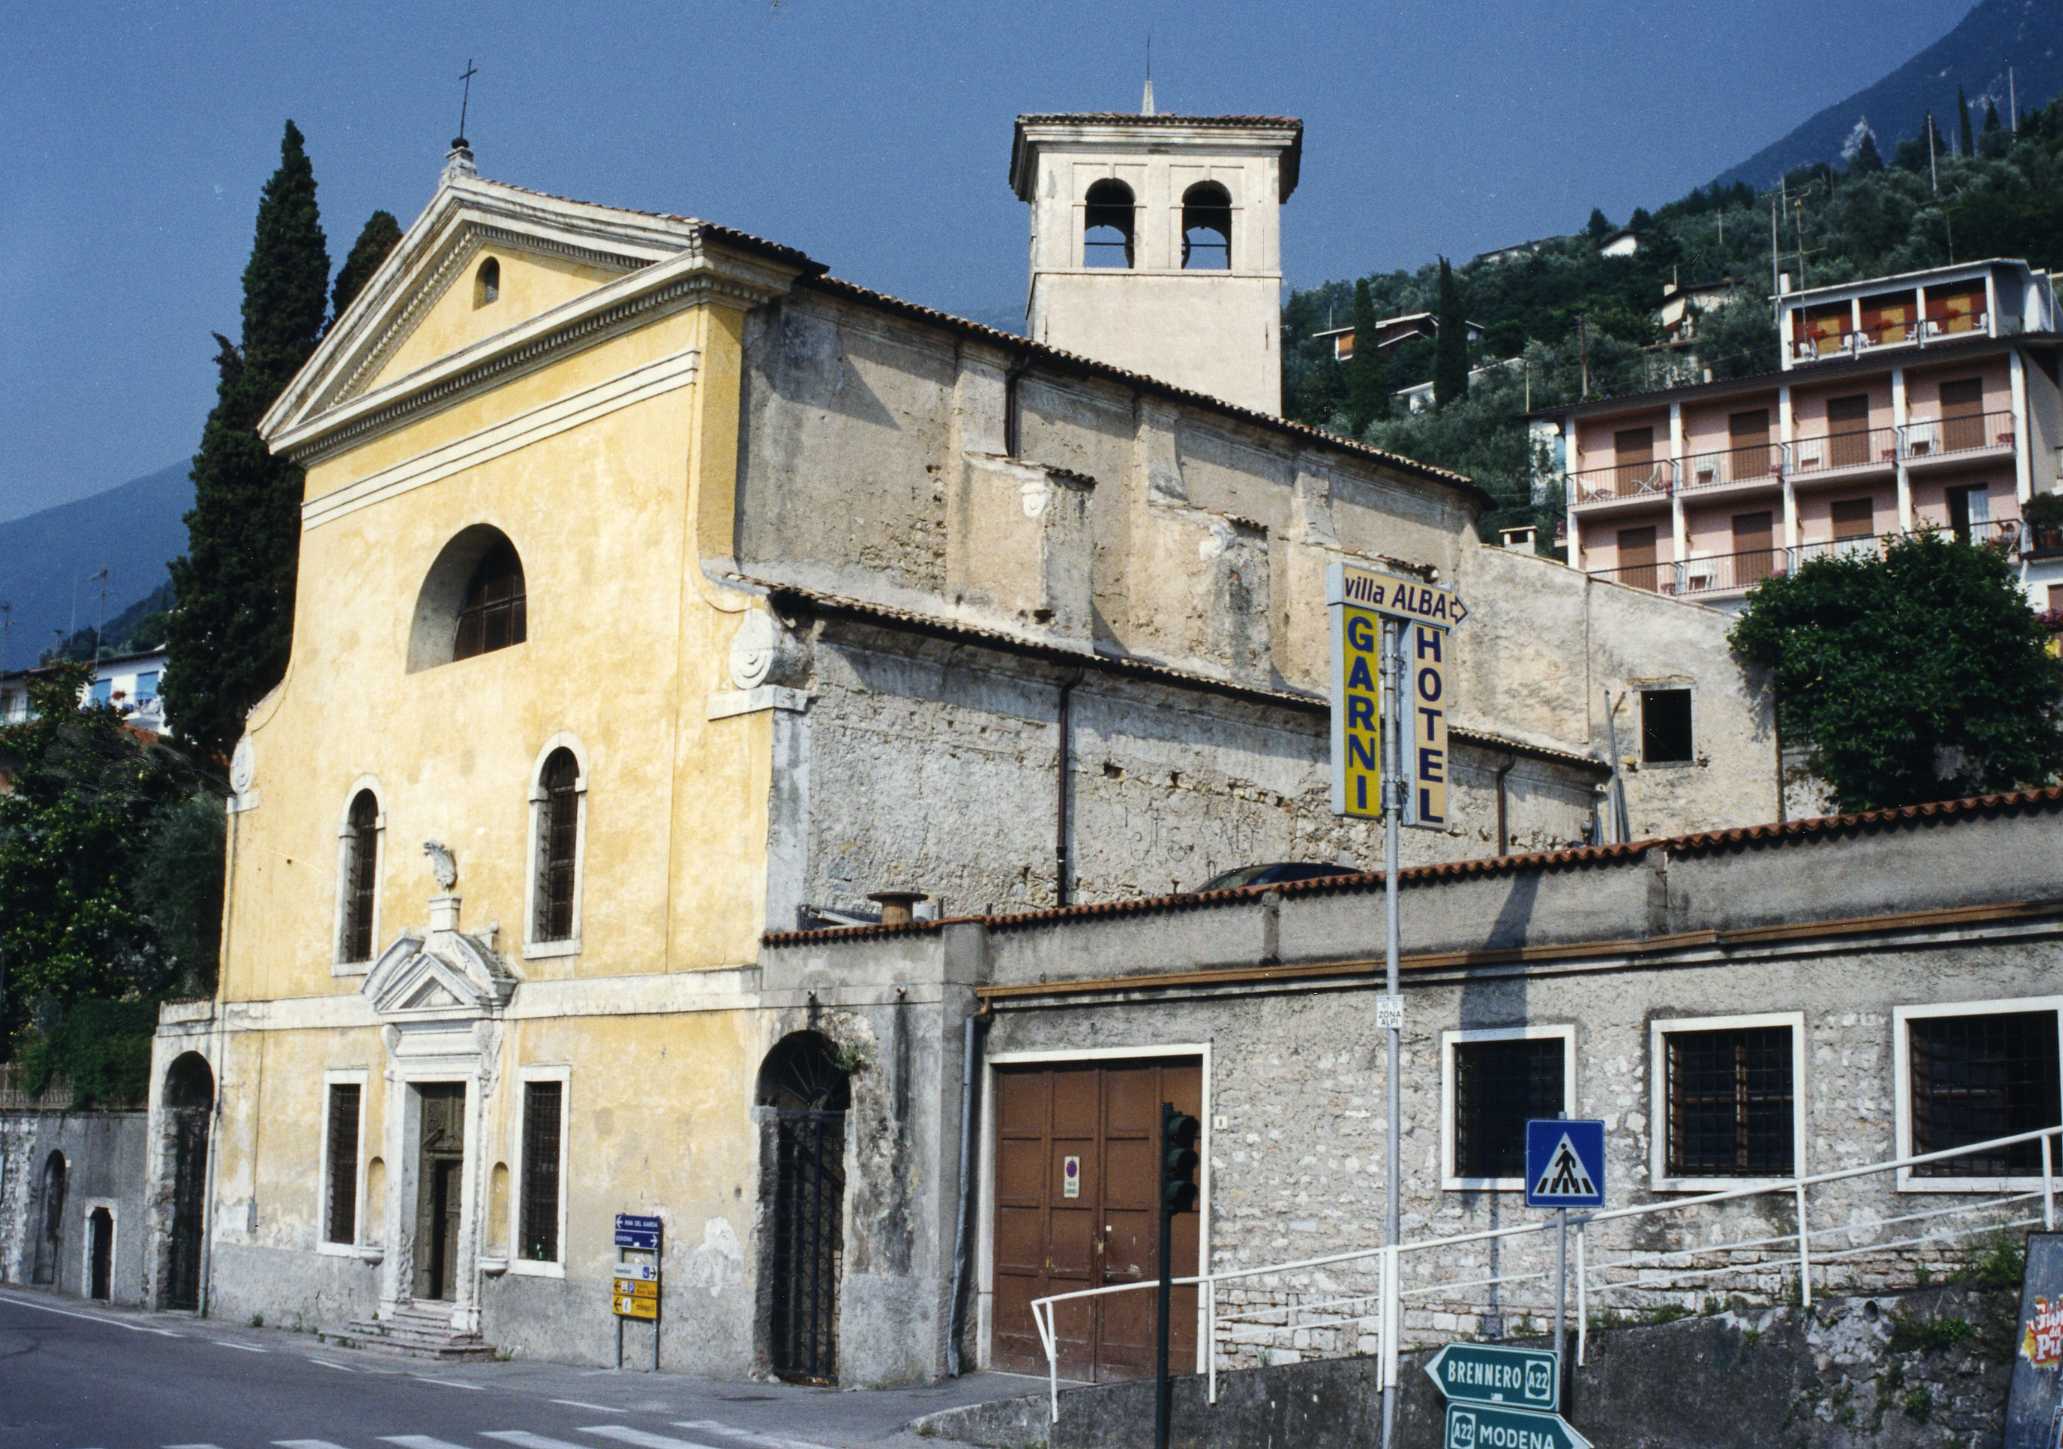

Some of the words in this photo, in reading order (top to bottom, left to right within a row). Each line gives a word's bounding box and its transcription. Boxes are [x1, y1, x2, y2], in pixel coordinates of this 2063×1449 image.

[1344, 576, 1385, 605] villa
[1392, 583, 1447, 619] ALBA
[1347, 615, 1376, 809] GARNI
[1416, 627, 1444, 823] HOTEL
[1447, 1360, 1522, 1389] BRENNERO
[1527, 1371, 1549, 1388] A22
[1452, 1424, 1473, 1440] A22
[1479, 1425, 1555, 1449] MODENA
